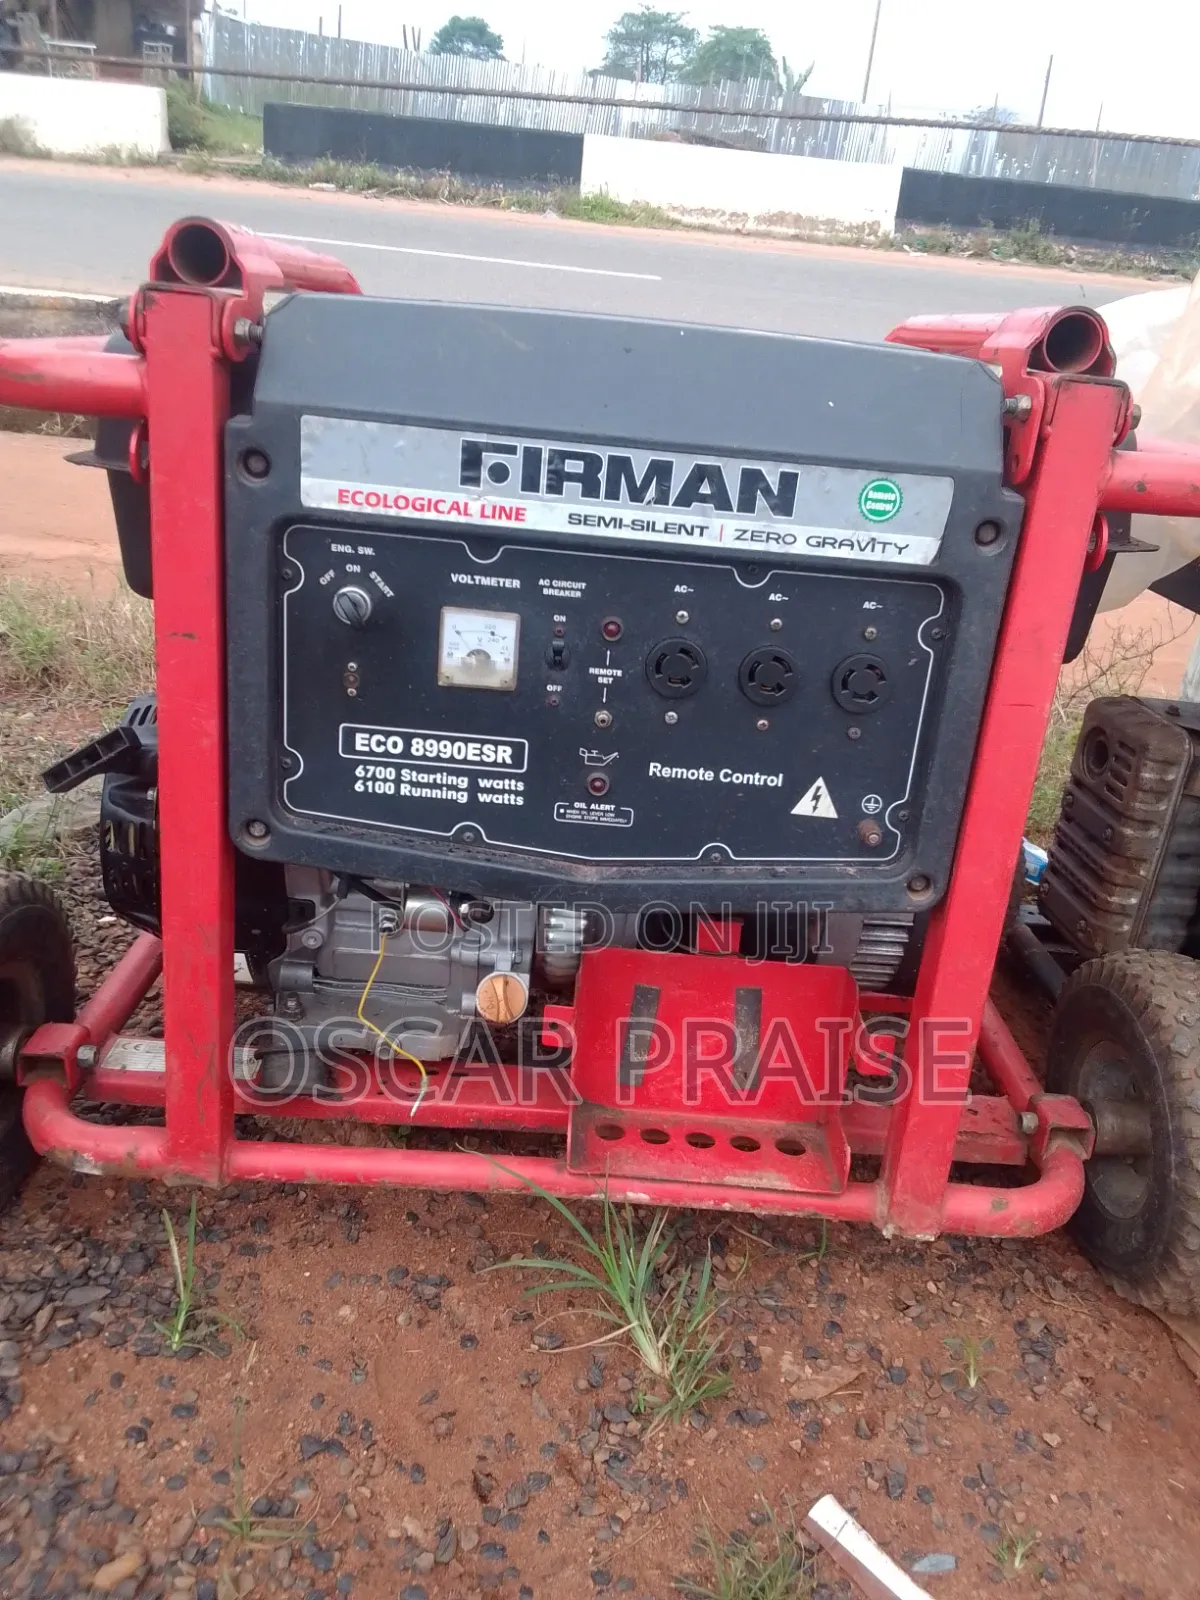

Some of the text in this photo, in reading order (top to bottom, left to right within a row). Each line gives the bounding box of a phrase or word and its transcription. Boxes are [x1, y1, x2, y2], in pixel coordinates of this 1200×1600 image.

[459, 437, 800, 518] FIRMAN
[337, 488, 527, 522] ECOLOGICAL LINE
[567, 512, 910, 555] SEMI-SILENT ZERO GRAVITY
[330, 543, 376, 556] ENG. SW.
[345, 563, 361, 573] ON
[319, 569, 336, 585] OFF
[369, 570, 395, 598] START
[450, 573, 521, 589] VOLTMETER
[538, 578, 587, 590] AC CIRCUIT
[542, 587, 582, 598] BREAKER
[553, 614, 567, 622] ON
[588, 667, 623, 677] REMOTE
[546, 684, 562, 692] OFF
[597, 676, 614, 685] SET
[354, 732, 513, 764] ECO 8990ESR
[354, 764, 525, 791] 6700 Starting watts
[648, 762, 784, 787] Remote Control
[354, 779, 525, 806] 6100 Running watts
[590, 803, 616, 811] ALERT
